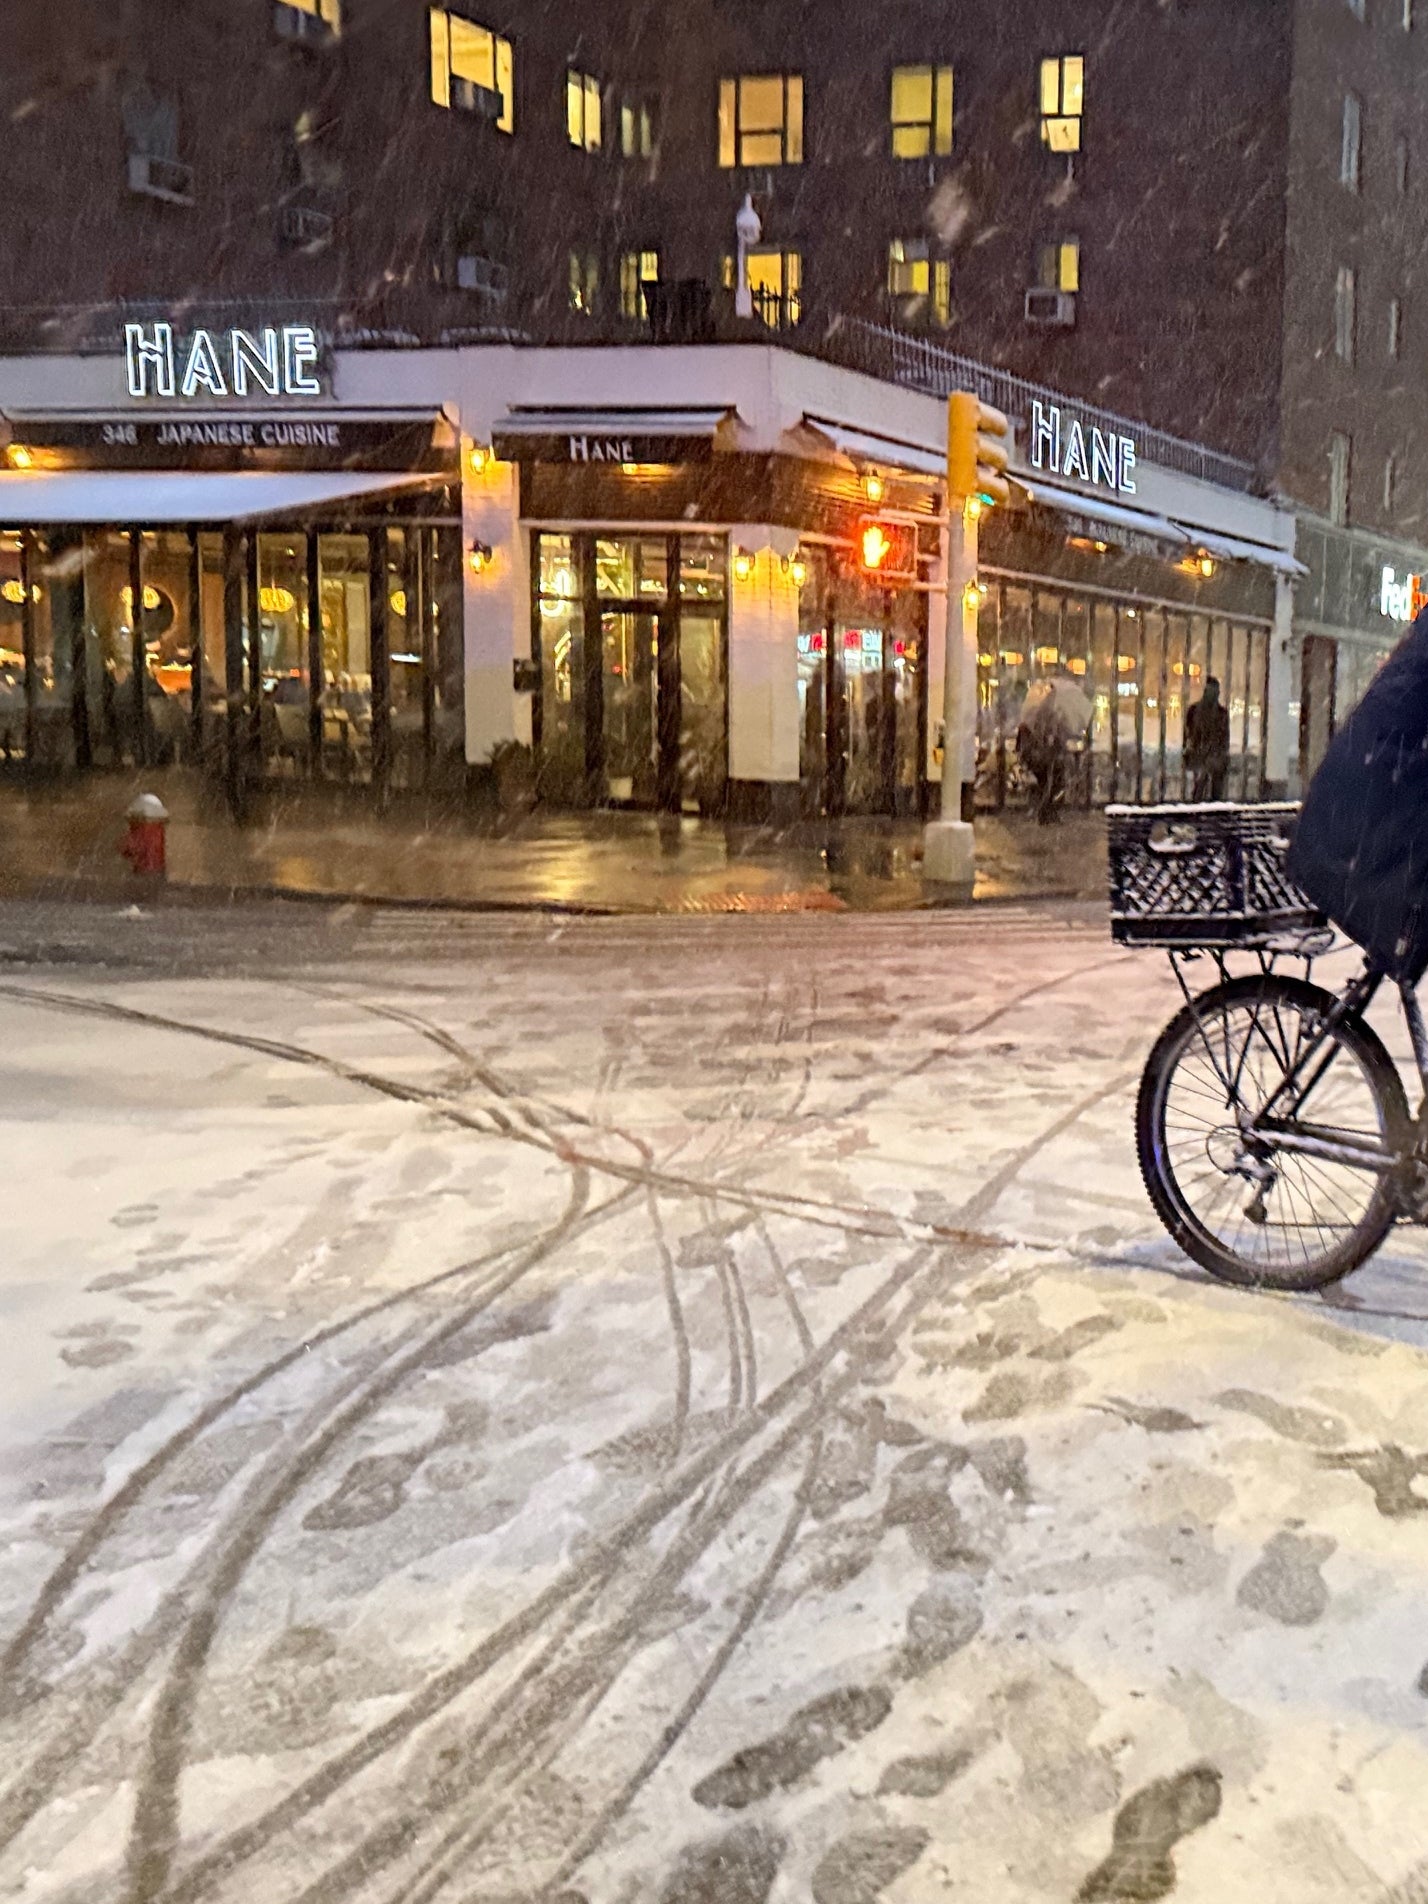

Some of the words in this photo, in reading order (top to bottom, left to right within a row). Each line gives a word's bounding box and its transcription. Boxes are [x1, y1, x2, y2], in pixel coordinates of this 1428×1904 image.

[125, 323, 320, 396] HANE
[157, 424, 254, 446] JAPANESE
[261, 424, 340, 446] CUISINE
[569, 435, 634, 462] HANE
[1032, 400, 1136, 494] HANE
